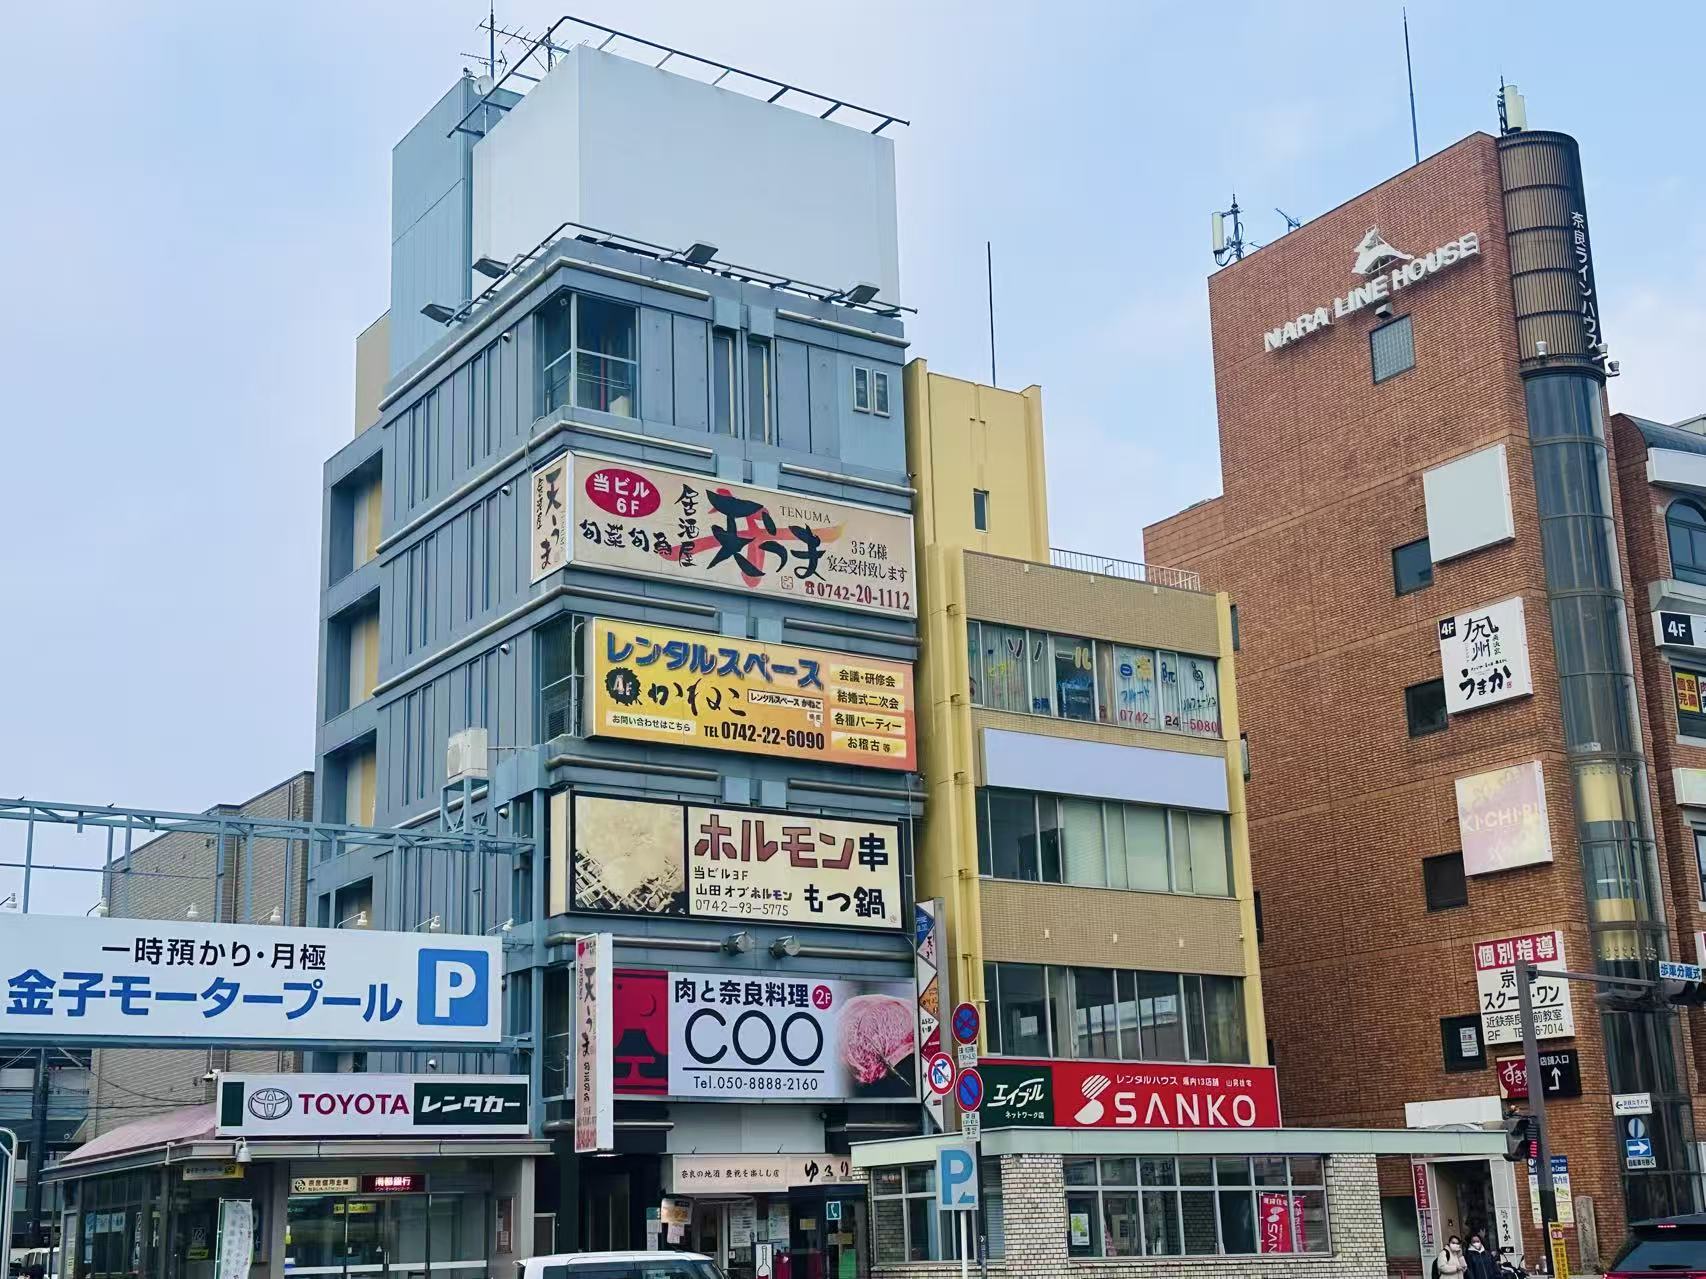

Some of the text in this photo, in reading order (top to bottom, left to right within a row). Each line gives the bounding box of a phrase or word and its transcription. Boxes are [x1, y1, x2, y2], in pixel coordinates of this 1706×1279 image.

[1264, 231, 1481, 353] NARA LINE HOUSE
[592, 472, 650, 498] 当ビル
[616, 497, 640, 515] 6F
[779, 505, 831, 524] TENUMA
[674, 484, 700, 568] 居酒屋
[851, 540, 888, 560] 35名様
[827, 555, 908, 583] 宴会受付致します
[817, 582, 910, 610] 0742-20-1112
[1441, 621, 1455, 636] 4F
[1667, 620, 1686, 637] 4F
[606, 631, 825, 690] レンタルスペース
[613, 674, 633, 697] 4F
[838, 669, 896, 687] 会議・研修会
[1459, 665, 1512, 701] うまか
[750, 692, 800, 706] レンタルスペース
[836, 690, 900, 710] 結婚式二次会
[612, 714, 692, 733] お問い合わせはこちら
[834, 712, 902, 732] 各種パーティー
[704, 722, 826, 751] TEL 0742-22-6090
[694, 813, 889, 873] ホルモン串
[694, 865, 749, 880] 当ビル3F
[695, 899, 789, 916] 0742-93-5775
[803, 883, 886, 919] もつ鍋
[101, 937, 327, 970] 一時預かり・月極
[1478, 935, 1555, 968] 個別指導
[1661, 964, 1701, 979] 歩車分離式
[6, 968, 403, 1022] 金子モータープール
[434, 960, 476, 1018] P
[675, 978, 809, 1009] 肉と奈良料理
[815, 988, 832, 1006] 2F
[1484, 986, 1560, 1011] スクー・ワン
[685, 1007, 825, 1066] COO
[1488, 1030, 1501, 1041] 2F
[1540, 1055, 1570, 1066] 店舗入口
[694, 1075, 819, 1092] Tel.050-8888-2160
[1116, 1074, 1179, 1086] レンタルハウス
[298, 1093, 521, 1115] TOYOTA レンタカー
[987, 1078, 1045, 1108] エイブル
[1114, 1091, 1256, 1127] SANKO
[940, 1149, 974, 1206] P
